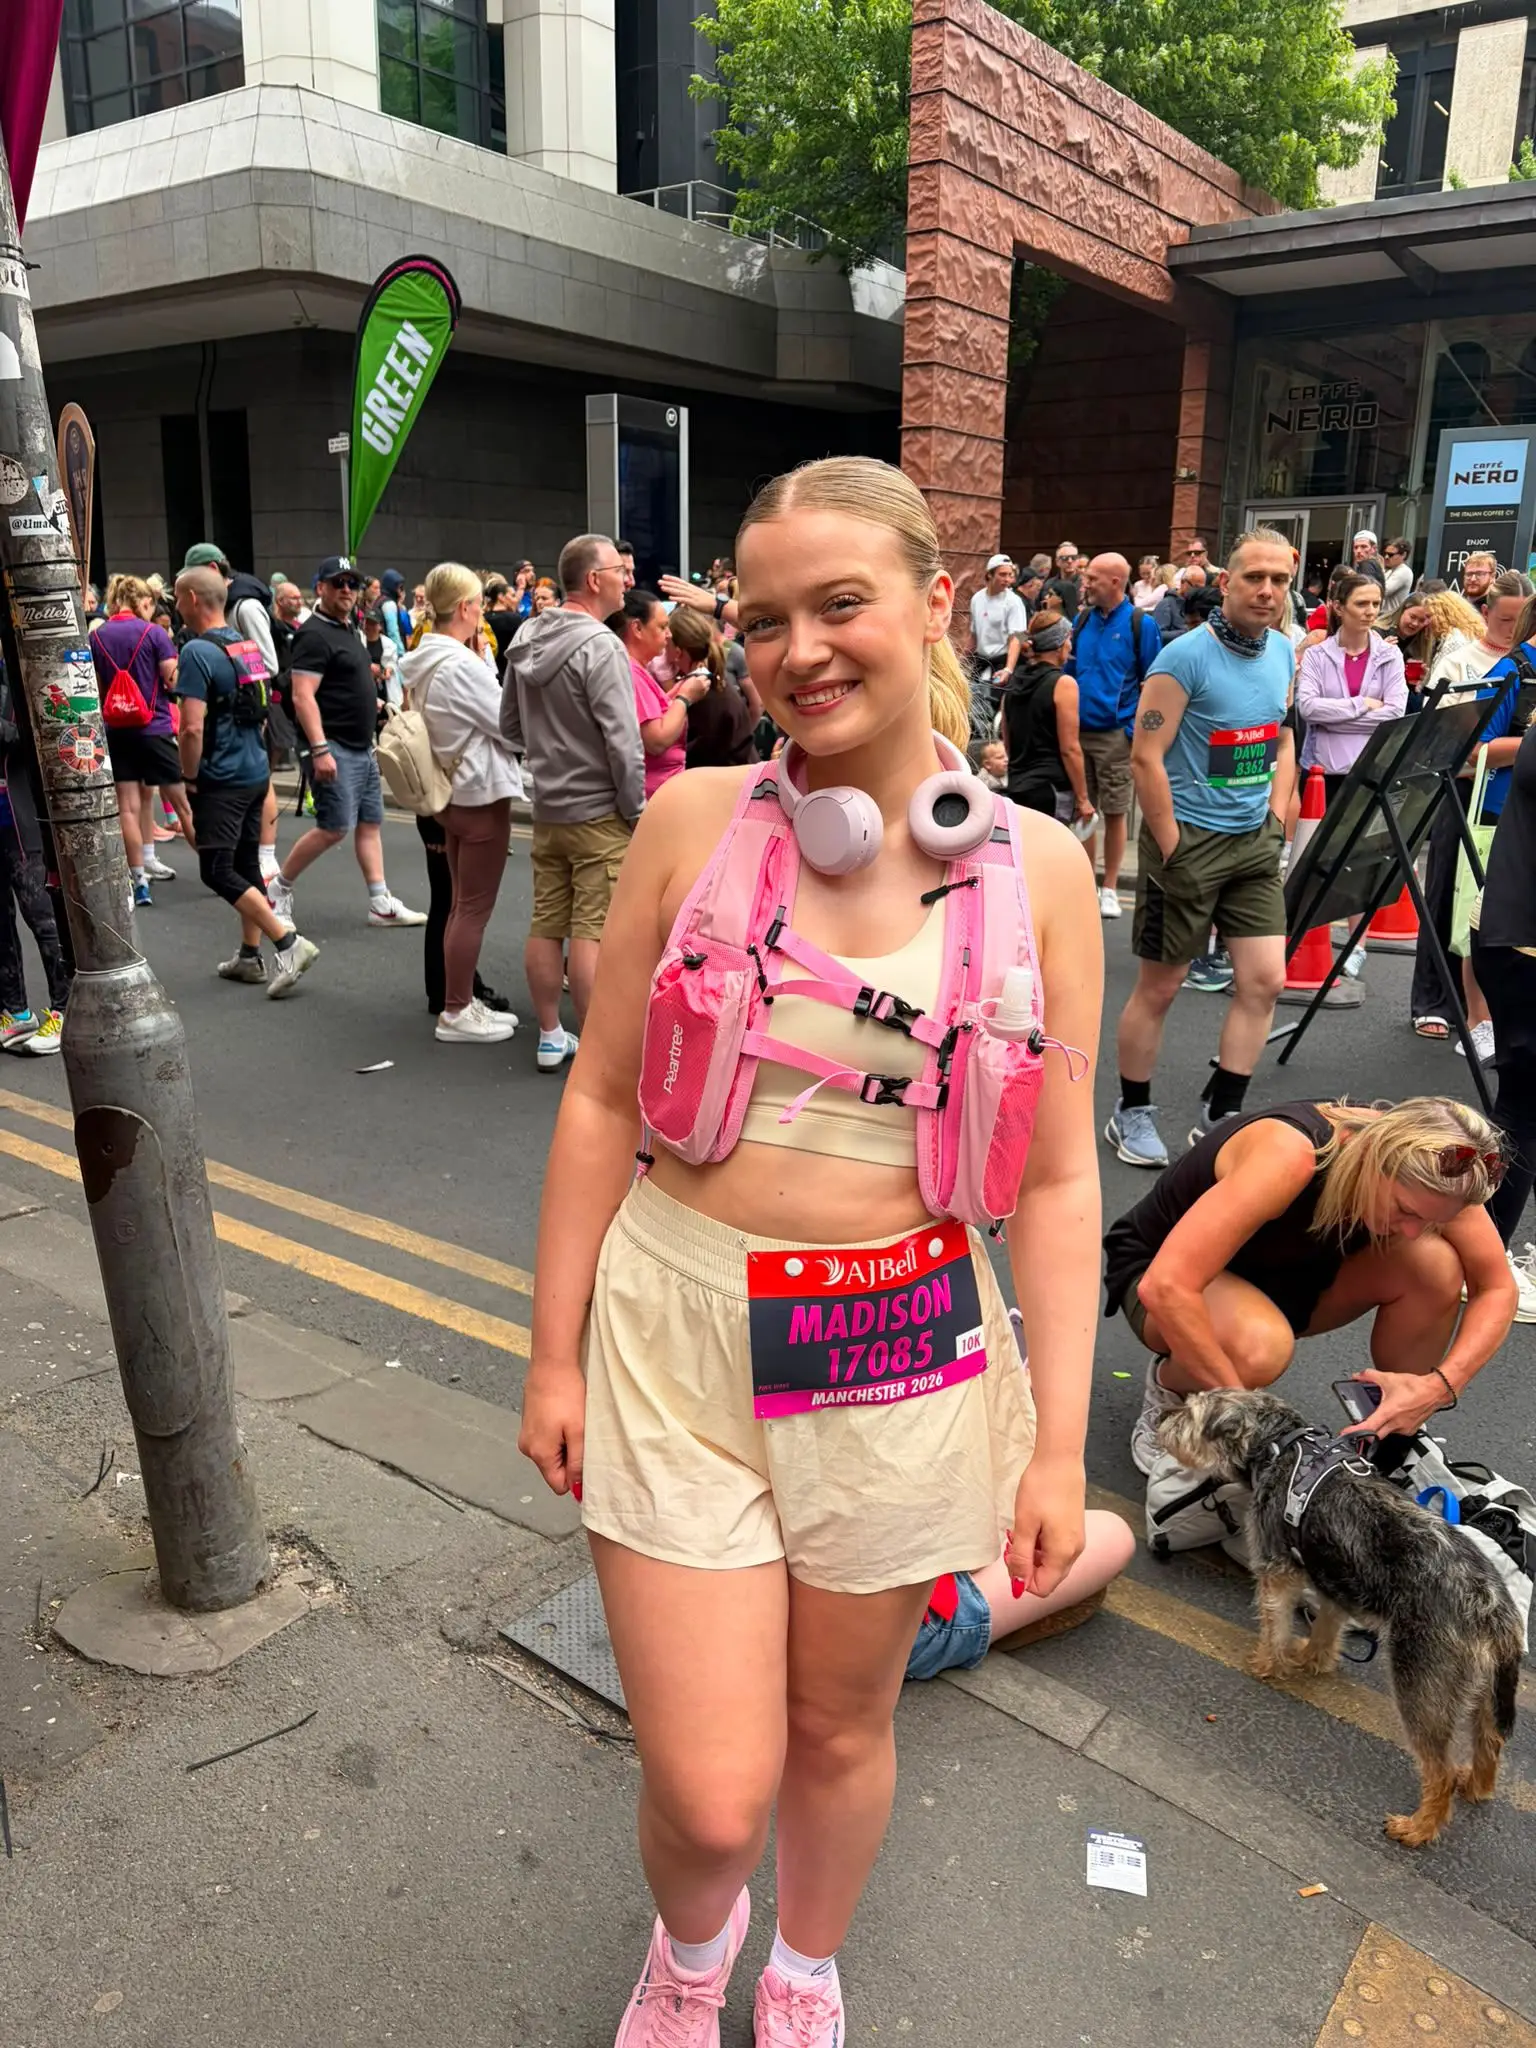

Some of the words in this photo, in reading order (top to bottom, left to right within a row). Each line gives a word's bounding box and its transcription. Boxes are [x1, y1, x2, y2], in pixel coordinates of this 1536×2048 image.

[361, 320, 433, 455] GREEN
[1266, 402, 1379, 434] NERO
[1454, 469, 1519, 485] NERO
[1482, 509, 1504, 517] COFFEE
[1466, 538, 1490, 546] ENJOY
[1233, 743, 1266, 760] DAVID
[1235, 759, 1265, 776] 8362
[663, 1023, 683, 1095] Peartree
[788, 1272, 953, 1345] MADISON
[961, 1332, 982, 1354] 10K
[828, 1330, 935, 1384] 17085
[811, 1381, 906, 1406] MANCHESTER
[911, 1371, 944, 1394] 2026
